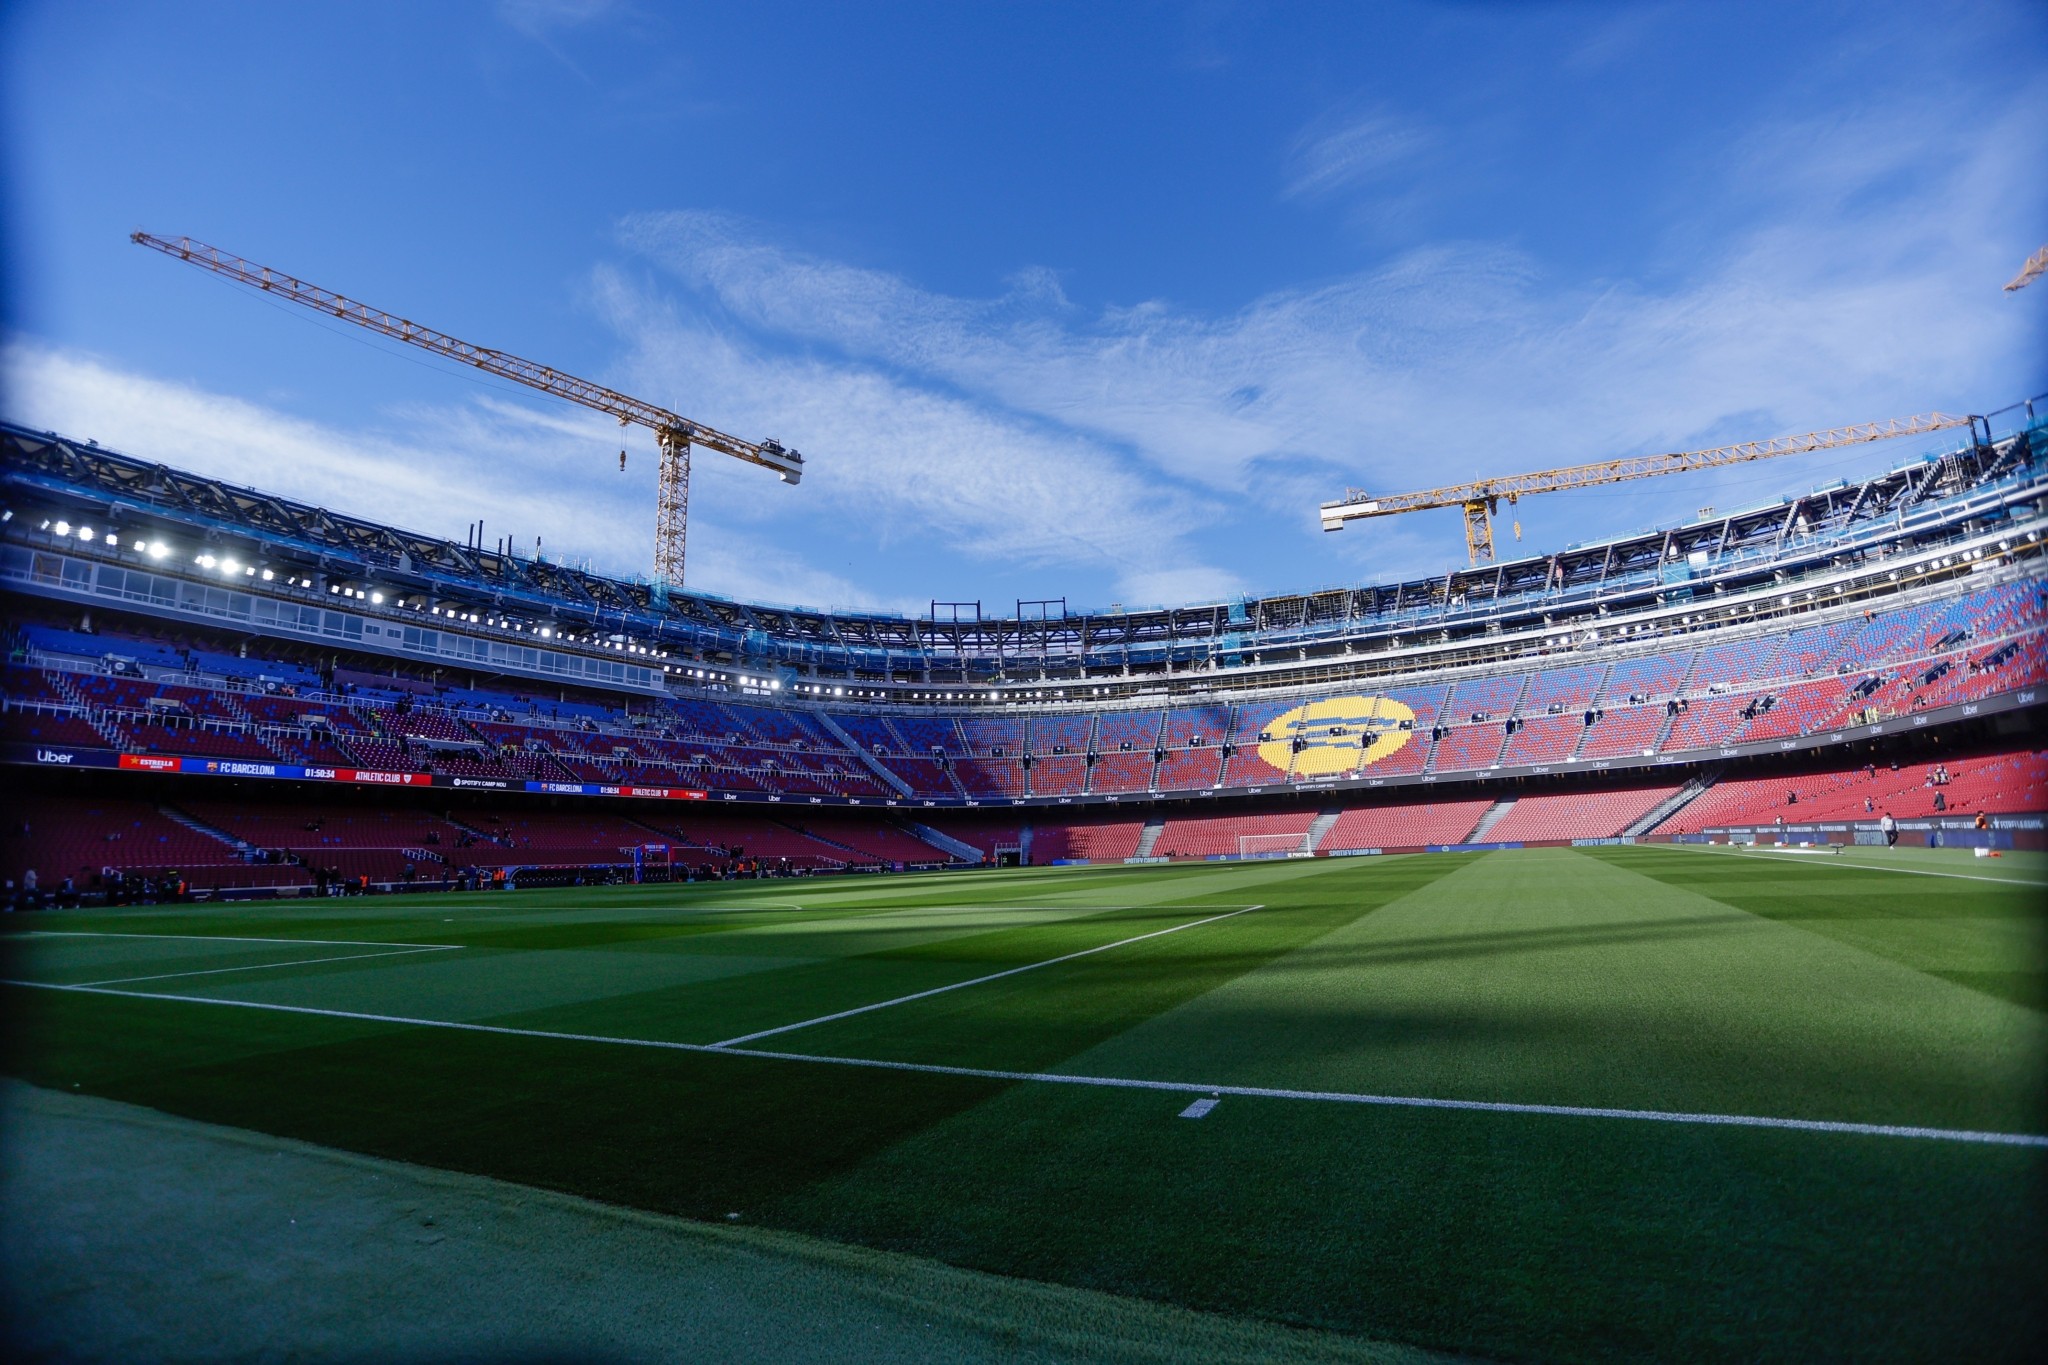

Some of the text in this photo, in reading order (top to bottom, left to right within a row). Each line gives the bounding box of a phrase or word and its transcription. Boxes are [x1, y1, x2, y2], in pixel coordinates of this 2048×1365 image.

[2018, 692, 2034, 704] Uber
[1962, 704, 1978, 716] Uber
[1913, 716, 1928, 725] Uber
[1870, 725, 1883, 734] Uber
[1831, 733, 1843, 741] Uber
[37, 749, 74, 764] Uber
[140, 759, 173, 767] ESTRELLA
[220, 763, 275, 775] FC BARCELONA
[305, 768, 335, 778] 01:50:34
[355, 772, 400, 783] ATHLETIC CLUB
[556, 784, 582, 793] BARCELONA
